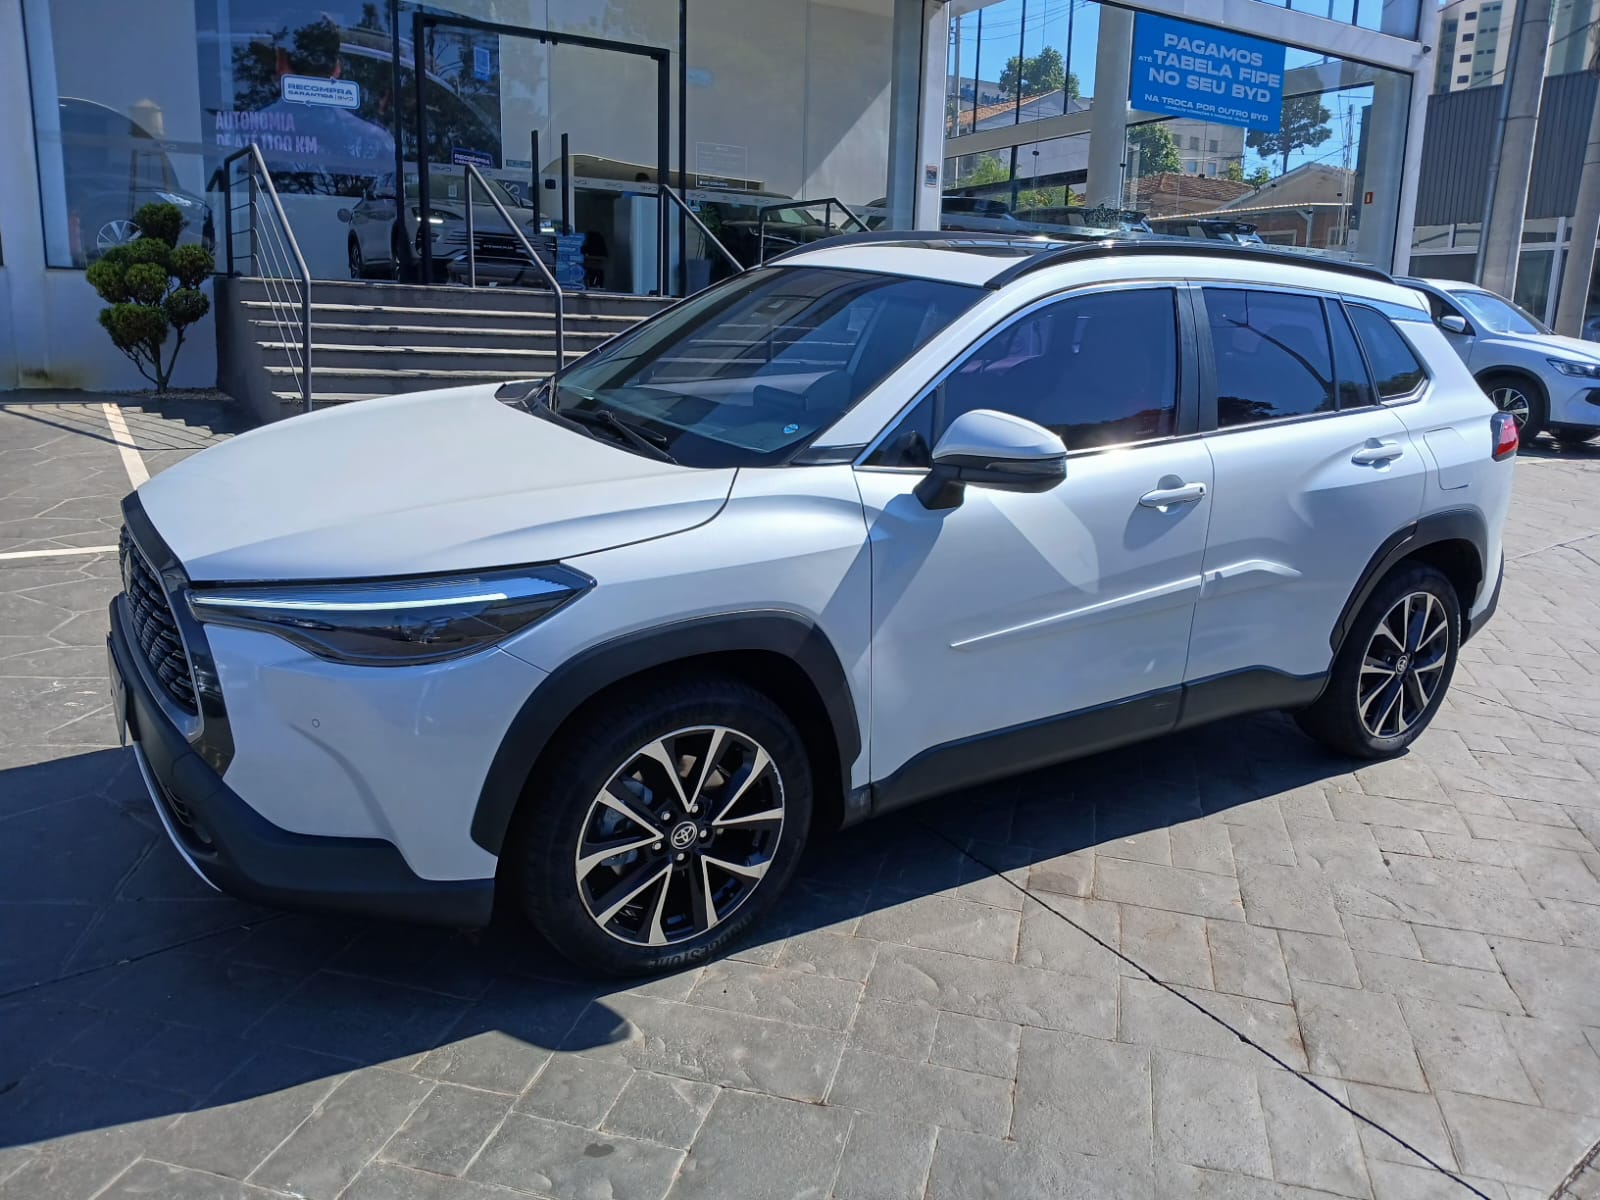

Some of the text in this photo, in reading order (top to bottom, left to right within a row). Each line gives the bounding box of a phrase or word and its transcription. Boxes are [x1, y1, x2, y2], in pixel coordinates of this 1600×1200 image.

[1164, 33, 1263, 66] PAGAMOS
[1154, 50, 1232, 79] TABELA
[1239, 67, 1280, 88] FIPE
[288, 83, 353, 95] RECOMPRA
[1149, 68, 1270, 103] NO SEU BYD
[216, 111, 295, 130] AUTONOMIA
[1144, 93, 1159, 103] NA
[1161, 96, 1194, 109] TROCA
[1196, 102, 1216, 112] POR
[1218, 106, 1248, 118] OUTRO
[1250, 113, 1268, 122] BYD
[261, 134, 292, 151] 1100
[295, 135, 317, 154] KM
